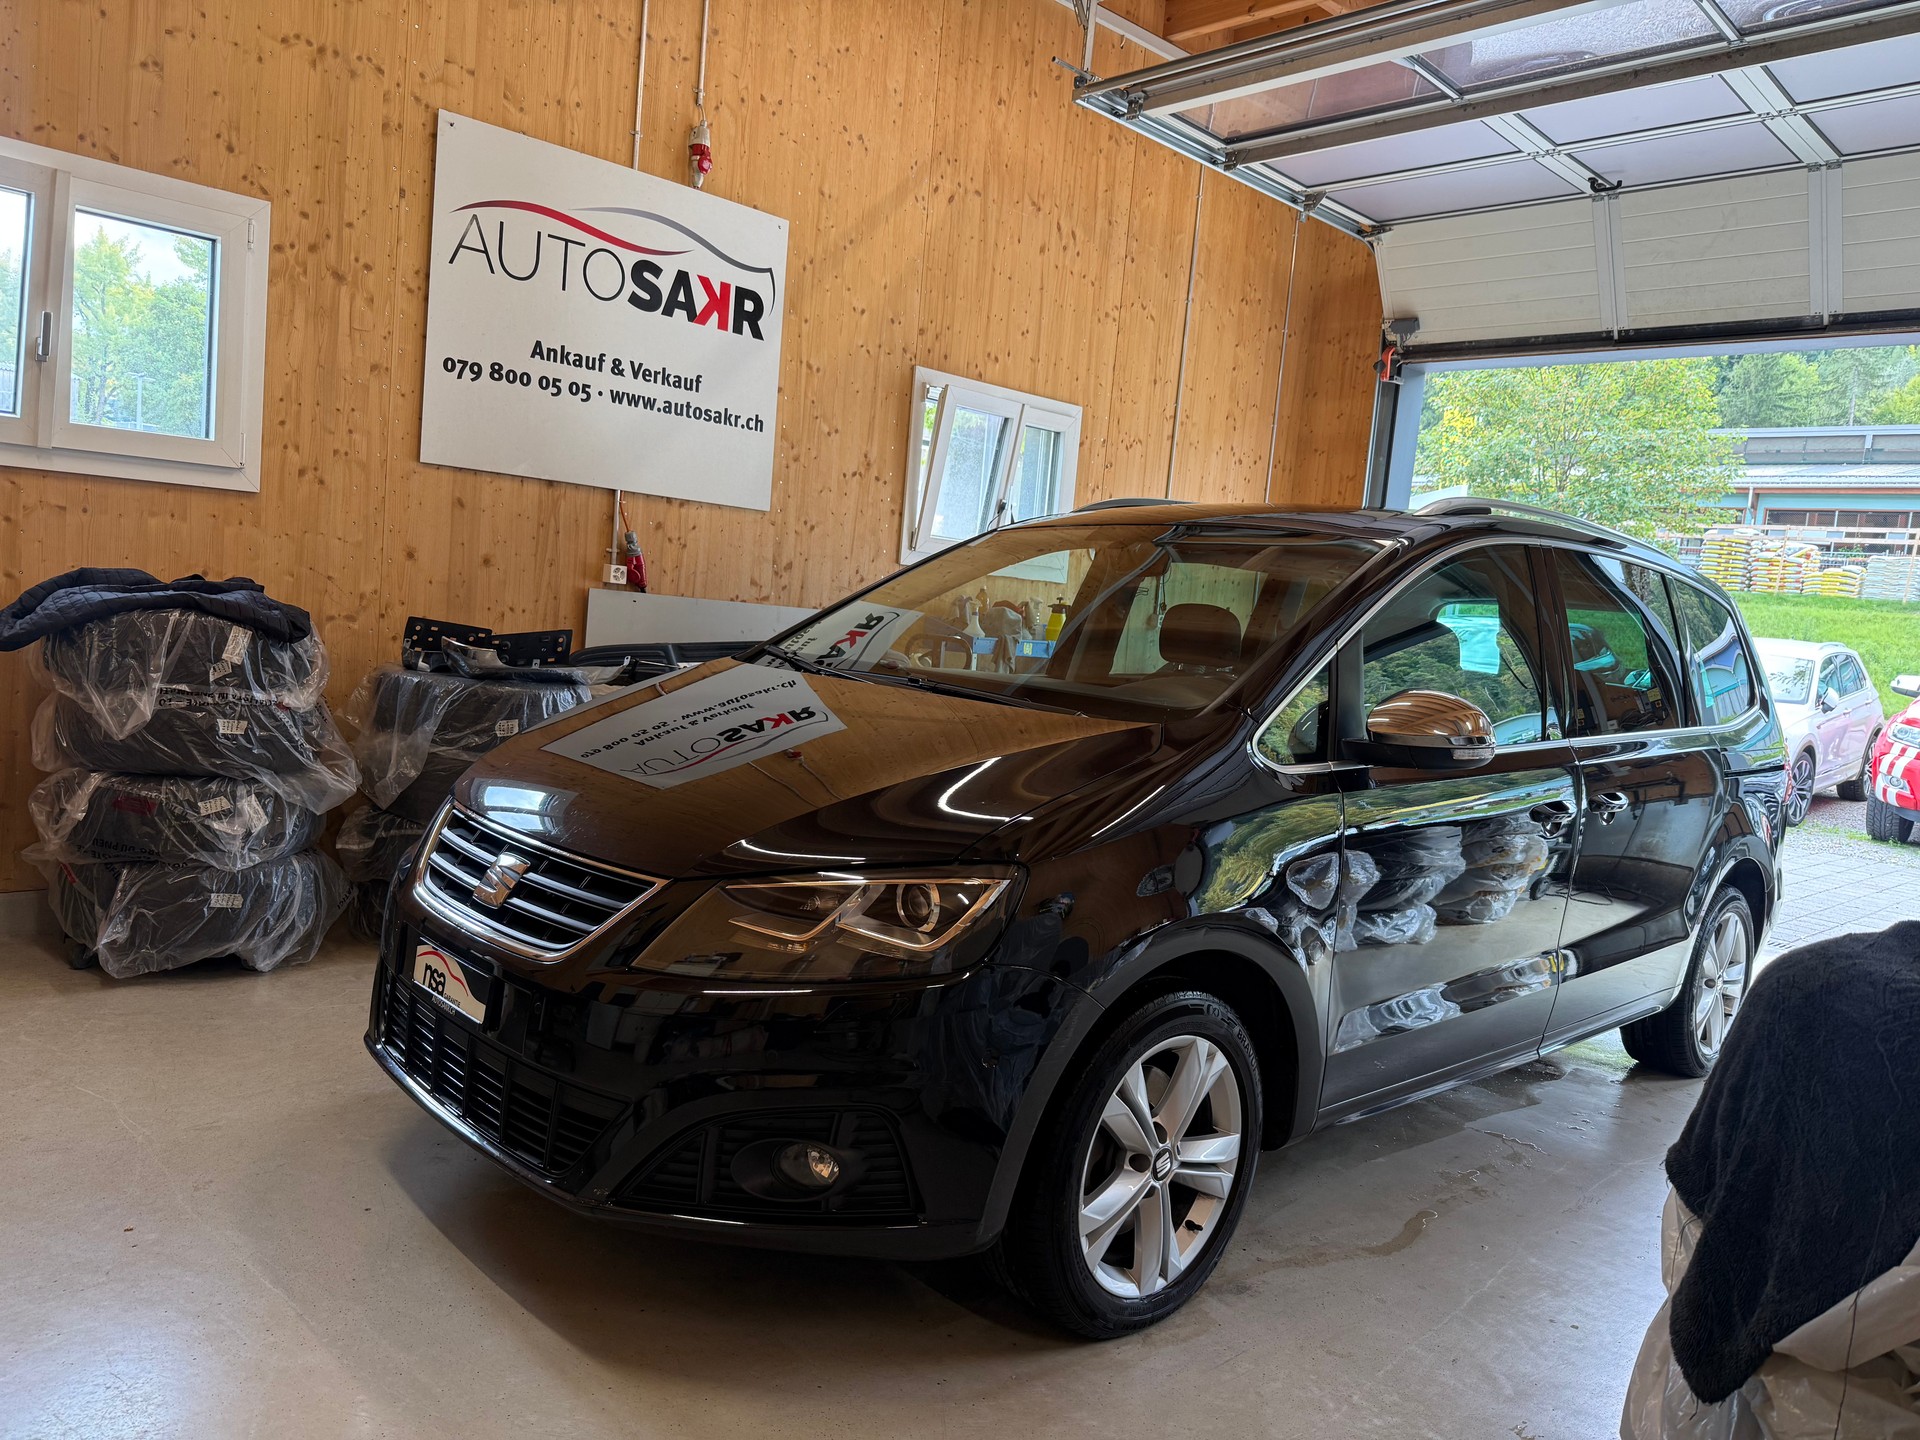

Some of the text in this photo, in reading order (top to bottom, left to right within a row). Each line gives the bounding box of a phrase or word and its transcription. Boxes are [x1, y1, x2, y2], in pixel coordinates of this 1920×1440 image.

[448, 213, 765, 341] AUTOSAKR
[443, 357, 765, 432] 079 800 05 05 www.autosakr.ch
[530, 340, 703, 393] Ankauf & Verkauf
